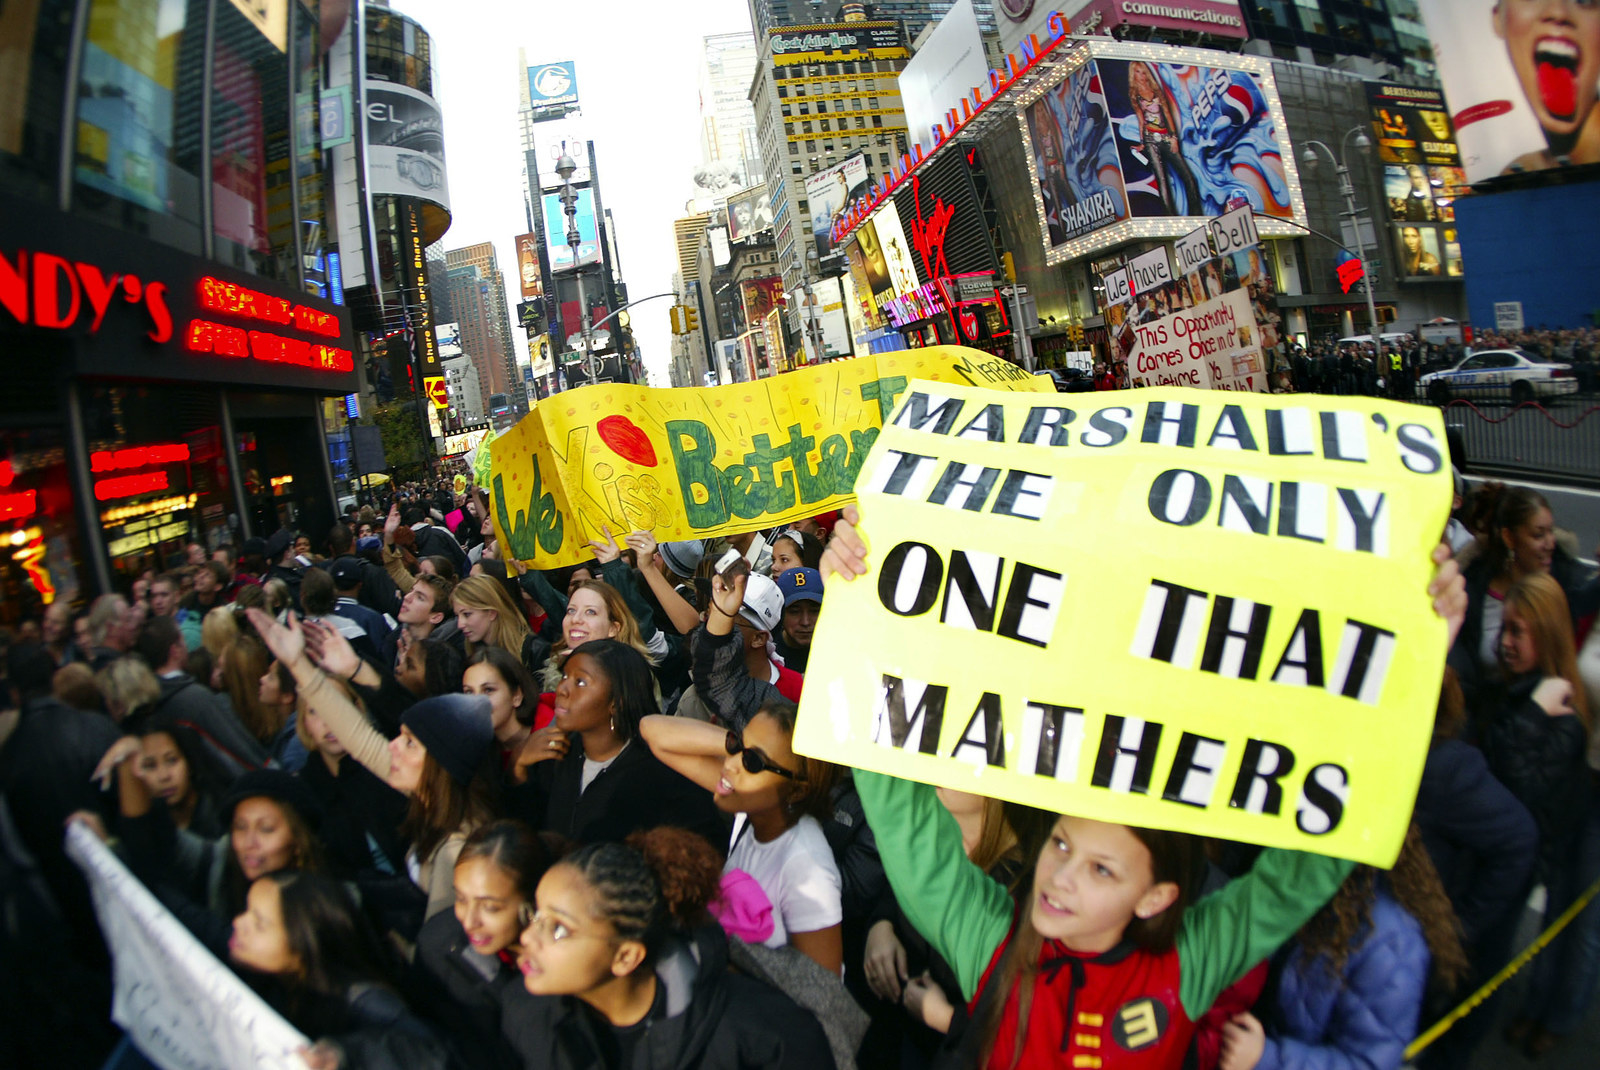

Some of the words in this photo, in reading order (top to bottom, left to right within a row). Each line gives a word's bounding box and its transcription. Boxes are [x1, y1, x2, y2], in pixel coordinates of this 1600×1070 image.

[1122, 1, 1241, 28] communications
[770, 34, 802, 53] Chock
[931, 10, 1070, 148] BUILDING
[1191, 69, 1233, 130] PEPSI
[1382, 86, 1441, 99] BERTELSMANN
[1068, 62, 1093, 145] PEPSI
[1061, 190, 1115, 232] SHAKIRA
[413, 236, 423, 269] Share
[1106, 279, 1128, 302] We
[1131, 261, 1168, 290] have
[1177, 240, 1208, 270] Taco
[1211, 214, 1253, 253] Bell
[962, 281, 993, 290] LOEWS
[482, 293, 493, 338] NOVOTEL
[1136, 325, 1168, 349] This
[1173, 301, 1236, 343] Opportunity
[425, 330, 435, 363] Share
[1137, 349, 1183, 373] Comes
[1189, 341, 1215, 361] Once
[891, 391, 1443, 474] MARSHALL'S
[493, 453, 563, 561] We
[549, 425, 673, 548] Kiss
[665, 419, 881, 529] Better
[882, 448, 1053, 521] THE
[1147, 467, 1386, 554] ONLY
[795, 572, 806, 587] B
[876, 540, 1063, 648] ONE
[1149, 578, 1396, 700] THAT
[875, 673, 1350, 836] MATHERS
